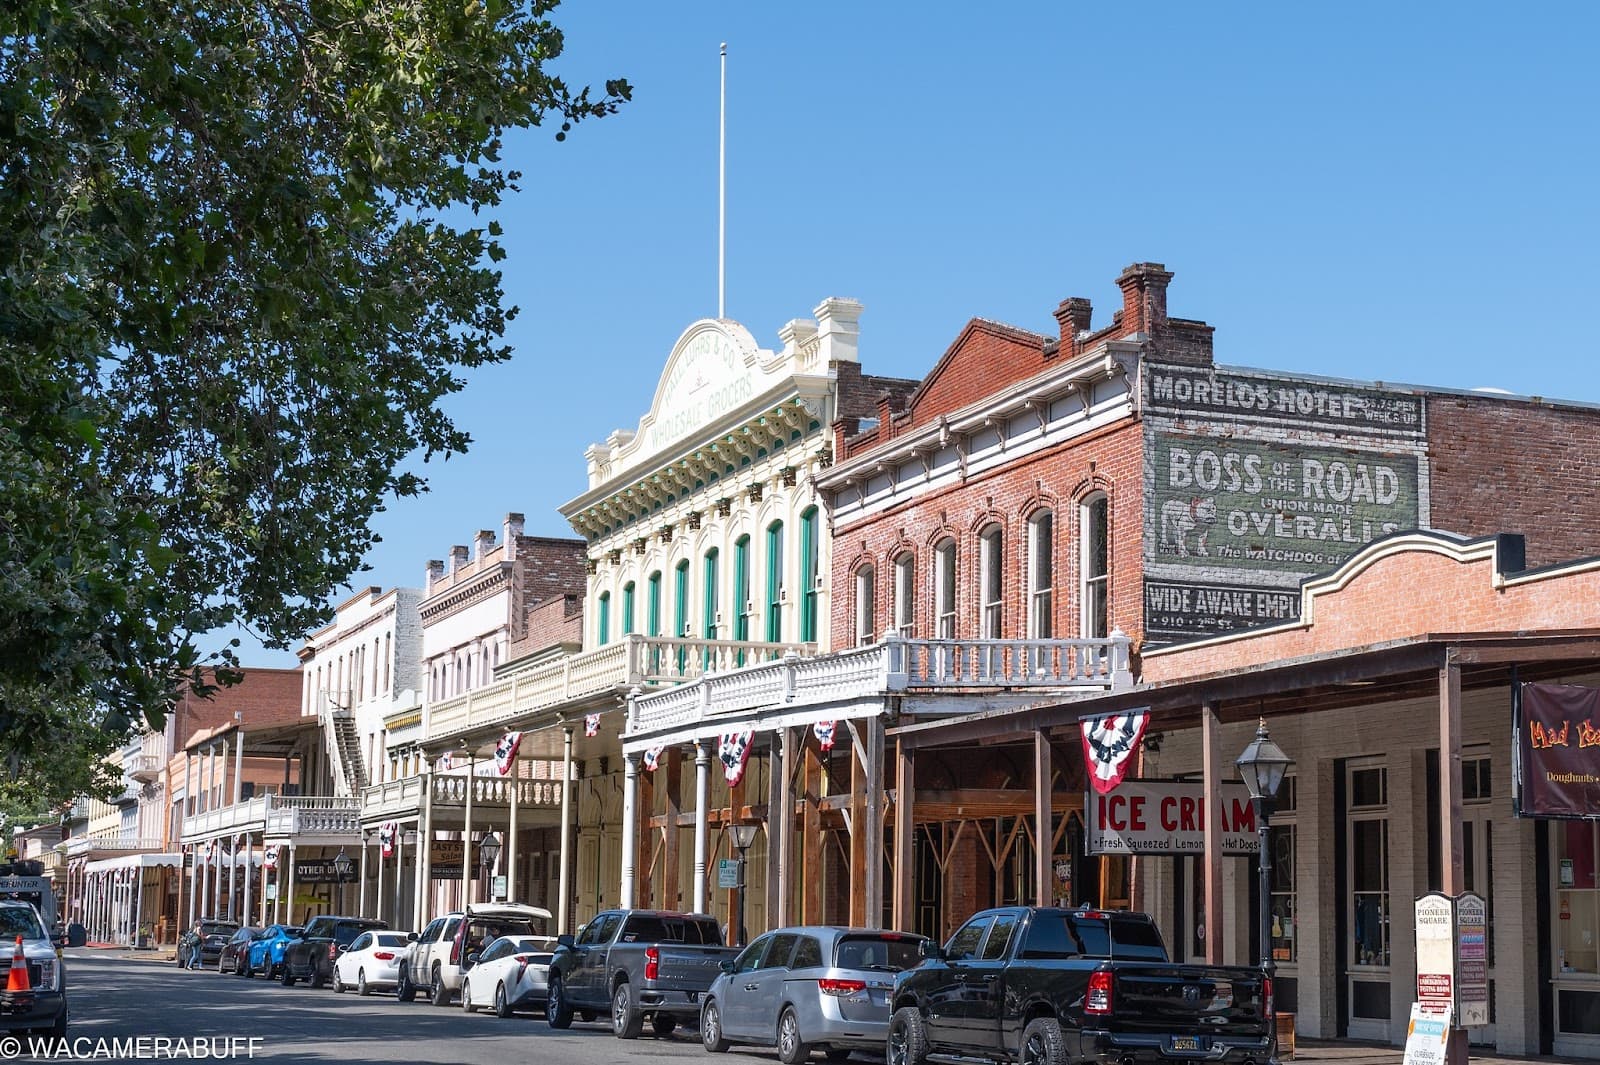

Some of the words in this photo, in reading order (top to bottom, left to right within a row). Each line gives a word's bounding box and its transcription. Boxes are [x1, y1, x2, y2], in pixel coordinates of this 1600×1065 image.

[1153, 374, 1269, 411] MORELOS
[1275, 388, 1357, 419] HOTEL
[651, 402, 703, 449] WHOLESALE
[708, 372, 752, 418] GROCERS
[1396, 401, 1416, 412] PER
[1364, 409, 1391, 423] WEEK
[1403, 412, 1417, 424] UP
[1169, 447, 1263, 495] BOSS
[1272, 462, 1291, 476] OF
[1268, 476, 1296, 492] THE
[1302, 459, 1399, 505] ROAD
[1261, 497, 1309, 512] UNION
[1313, 502, 1353, 515] MADE
[1216, 545, 1241, 558] The
[1245, 548, 1323, 564] WATCHDOG
[1327, 552, 1342, 565] of
[1150, 587, 1191, 613] WIDE
[1195, 590, 1251, 617] AWAKE
[1161, 616, 1184, 627] 910
[1530, 719, 1569, 748] Mad
[1546, 771, 1594, 784] Doughnuts
[1098, 795, 1146, 831] ICE
[1099, 837, 1123, 848] Fresh
[1127, 837, 1170, 851] Squeezed
[1175, 837, 1204, 849] Lemon
[1225, 837, 1237, 849] Hot
[298, 865, 324, 875] OTHER
[1417, 908, 1450, 916] PIONEER
[1458, 908, 1484, 916] PIONEER
[1419, 917, 1448, 925] SQUARE
